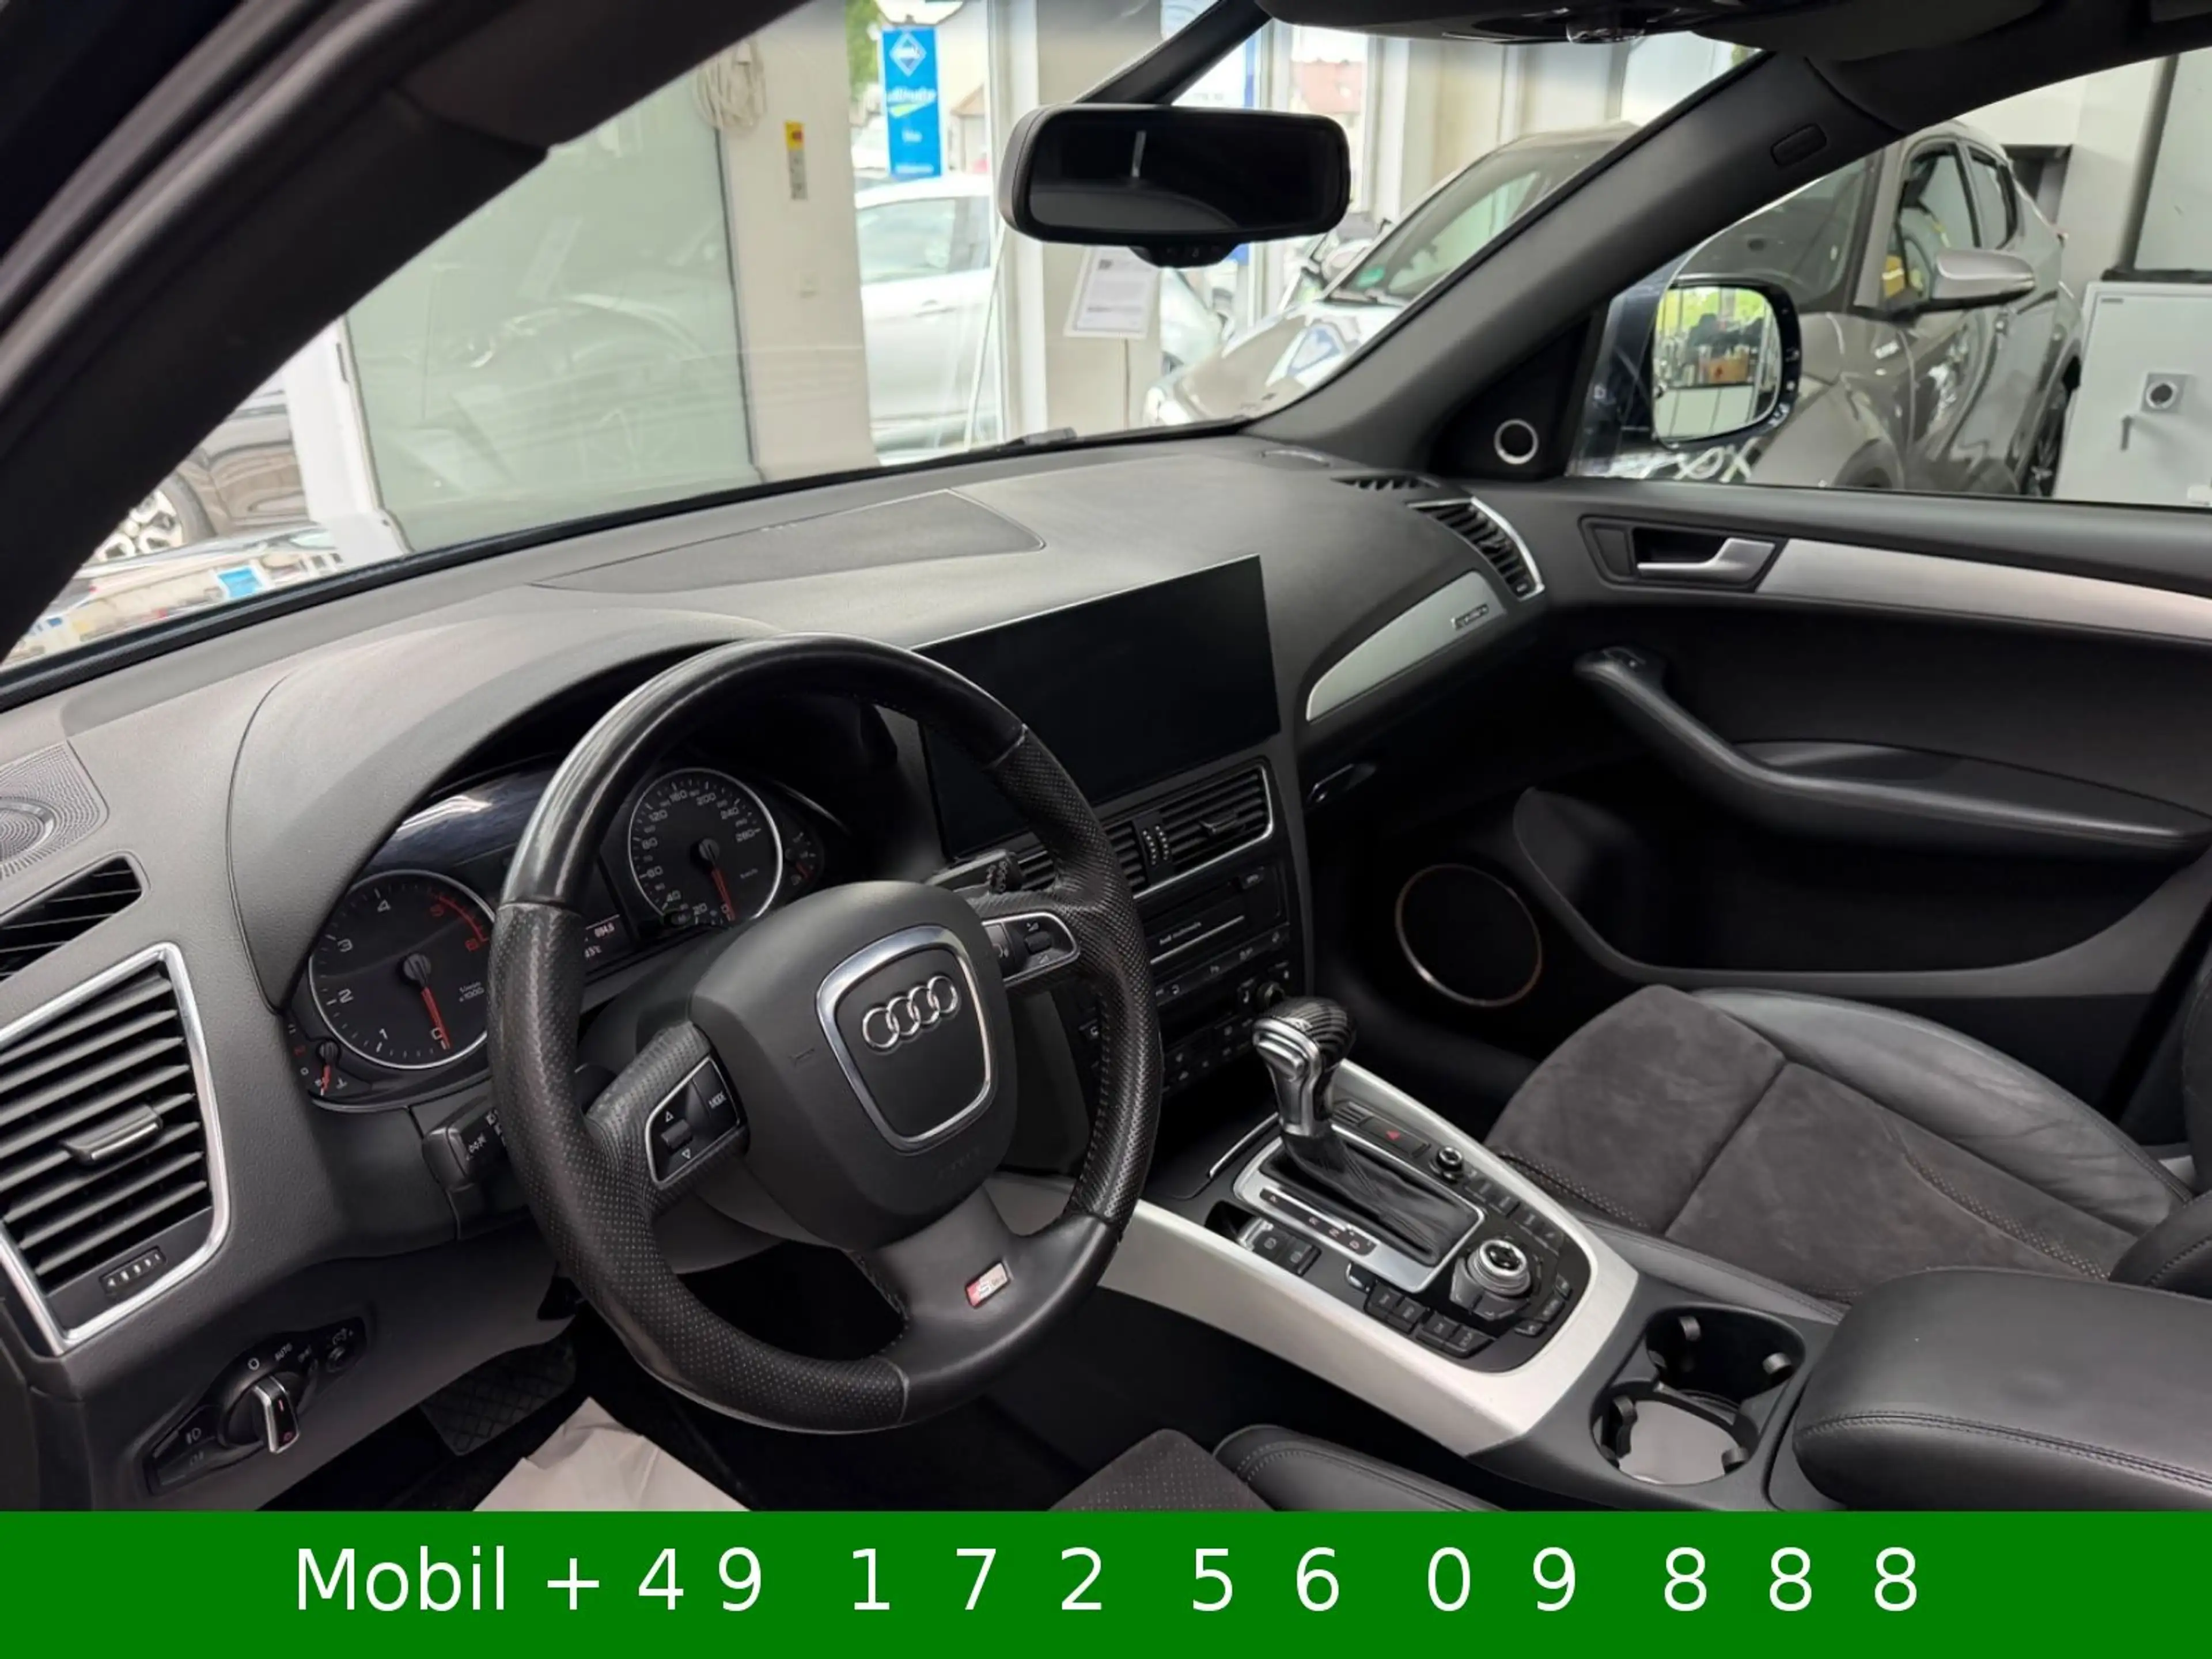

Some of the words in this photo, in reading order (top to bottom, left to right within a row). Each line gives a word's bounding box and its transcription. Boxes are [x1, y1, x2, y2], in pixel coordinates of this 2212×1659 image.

[377, 899, 391, 912] 4
[338, 938, 353, 952] 3
[339, 988, 354, 1003] 2
[379, 1028, 389, 1040] 1
